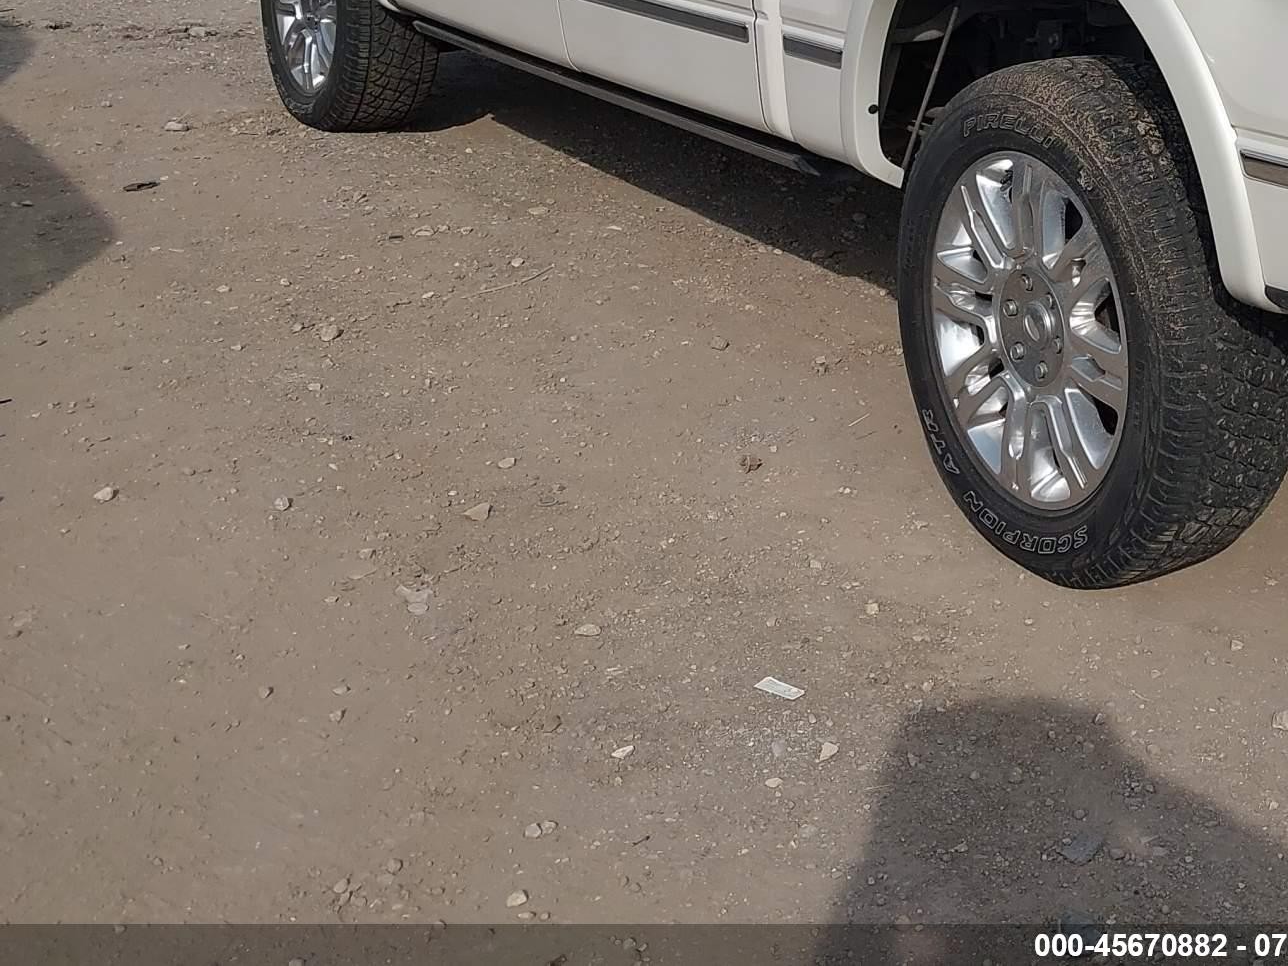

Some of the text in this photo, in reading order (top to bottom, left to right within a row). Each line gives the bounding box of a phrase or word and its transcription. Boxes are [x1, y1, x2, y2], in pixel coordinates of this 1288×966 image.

[963, 113, 1056, 149] PIRELLI
[922, 409, 1088, 554] SCORPION ATR
